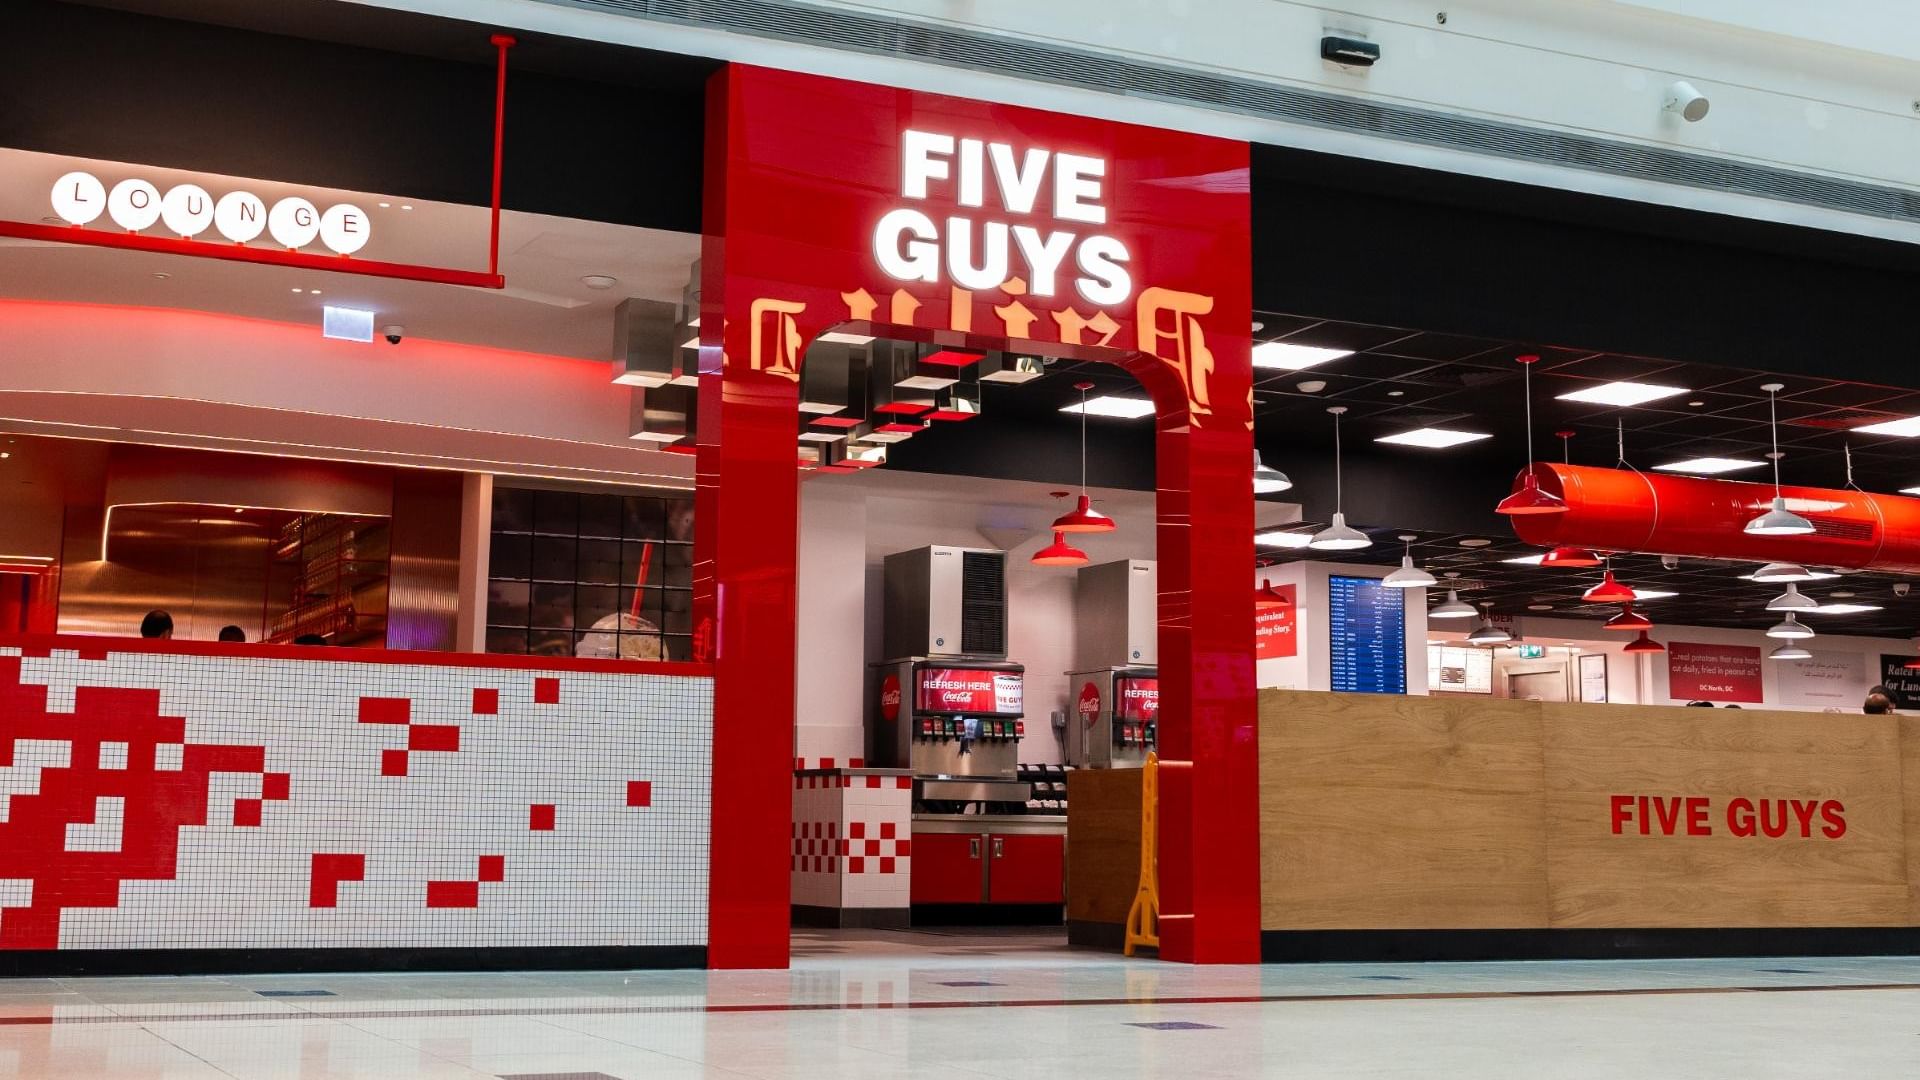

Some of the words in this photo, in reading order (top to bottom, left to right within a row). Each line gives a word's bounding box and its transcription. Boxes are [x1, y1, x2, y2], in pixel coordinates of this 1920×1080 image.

[902, 129, 1106, 224] FIVE
[74, 182, 358, 233] LOUNGE
[873, 208, 1132, 305] GUYS
[1479, 612, 1513, 622] ODER
[1717, 666, 1724, 674] in
[1888, 663, 1914, 677] Rated
[923, 680, 966, 690] REFRESH
[968, 681, 991, 691] HERE
[1885, 679, 1899, 690] for
[1610, 795, 1712, 836] FIVE
[1726, 797, 1847, 839] GUYS
